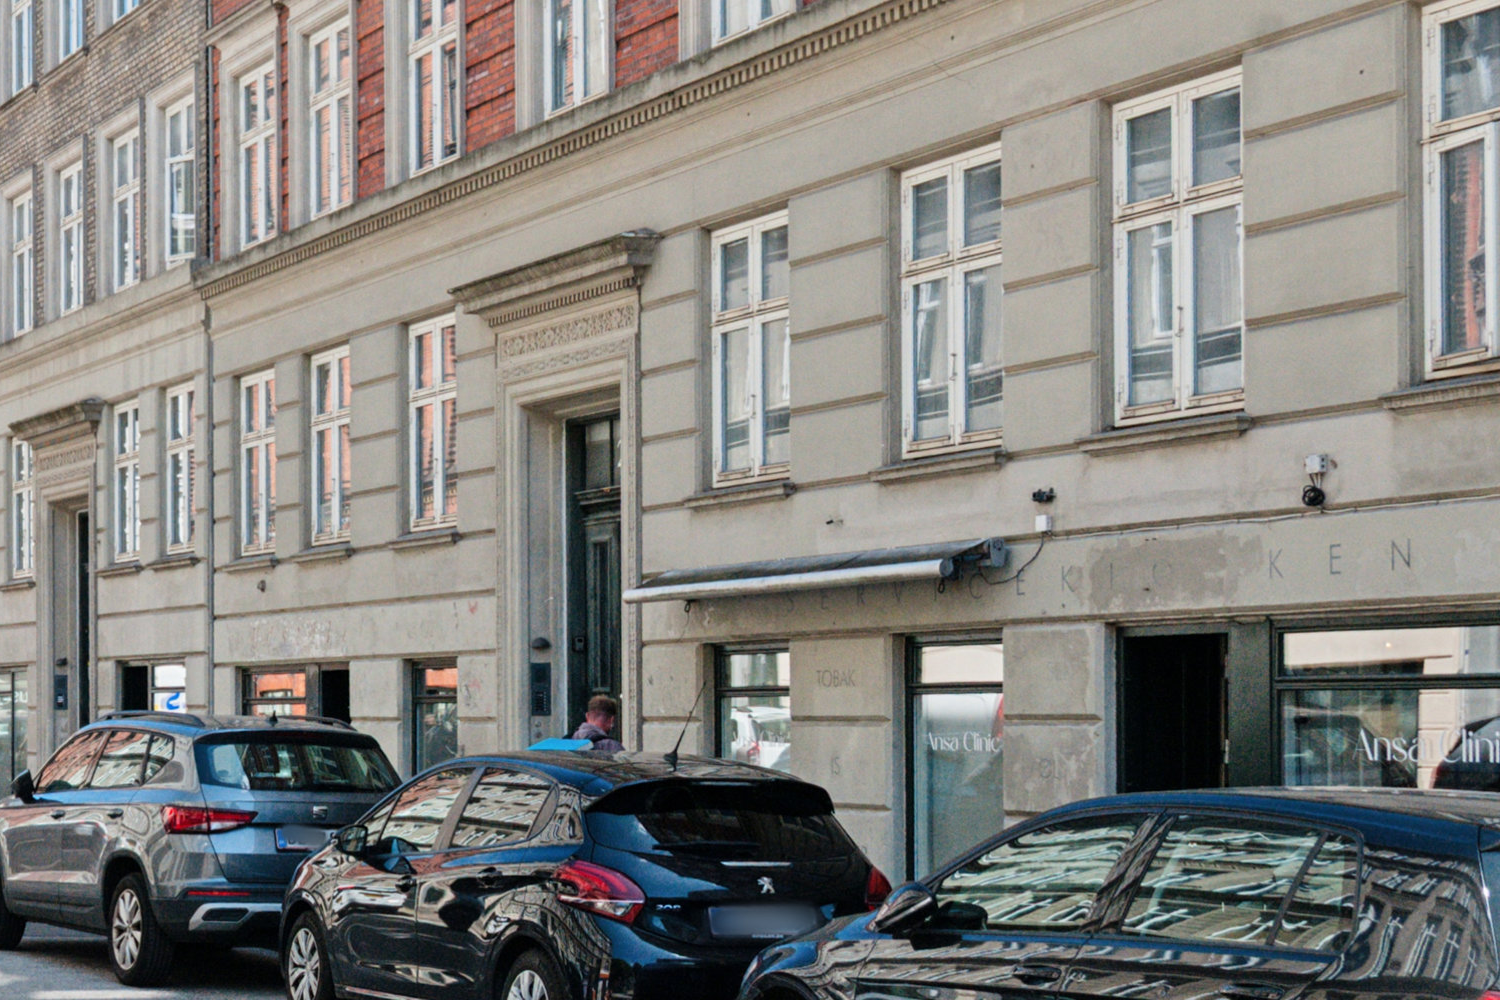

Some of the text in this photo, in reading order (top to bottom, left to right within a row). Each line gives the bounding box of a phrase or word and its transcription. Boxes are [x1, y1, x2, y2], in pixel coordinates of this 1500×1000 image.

[816, 669, 856, 688] TOBAK
[927, 731, 1000, 752] Ansa Clinic
[1351, 728, 1434, 763] Ansa
